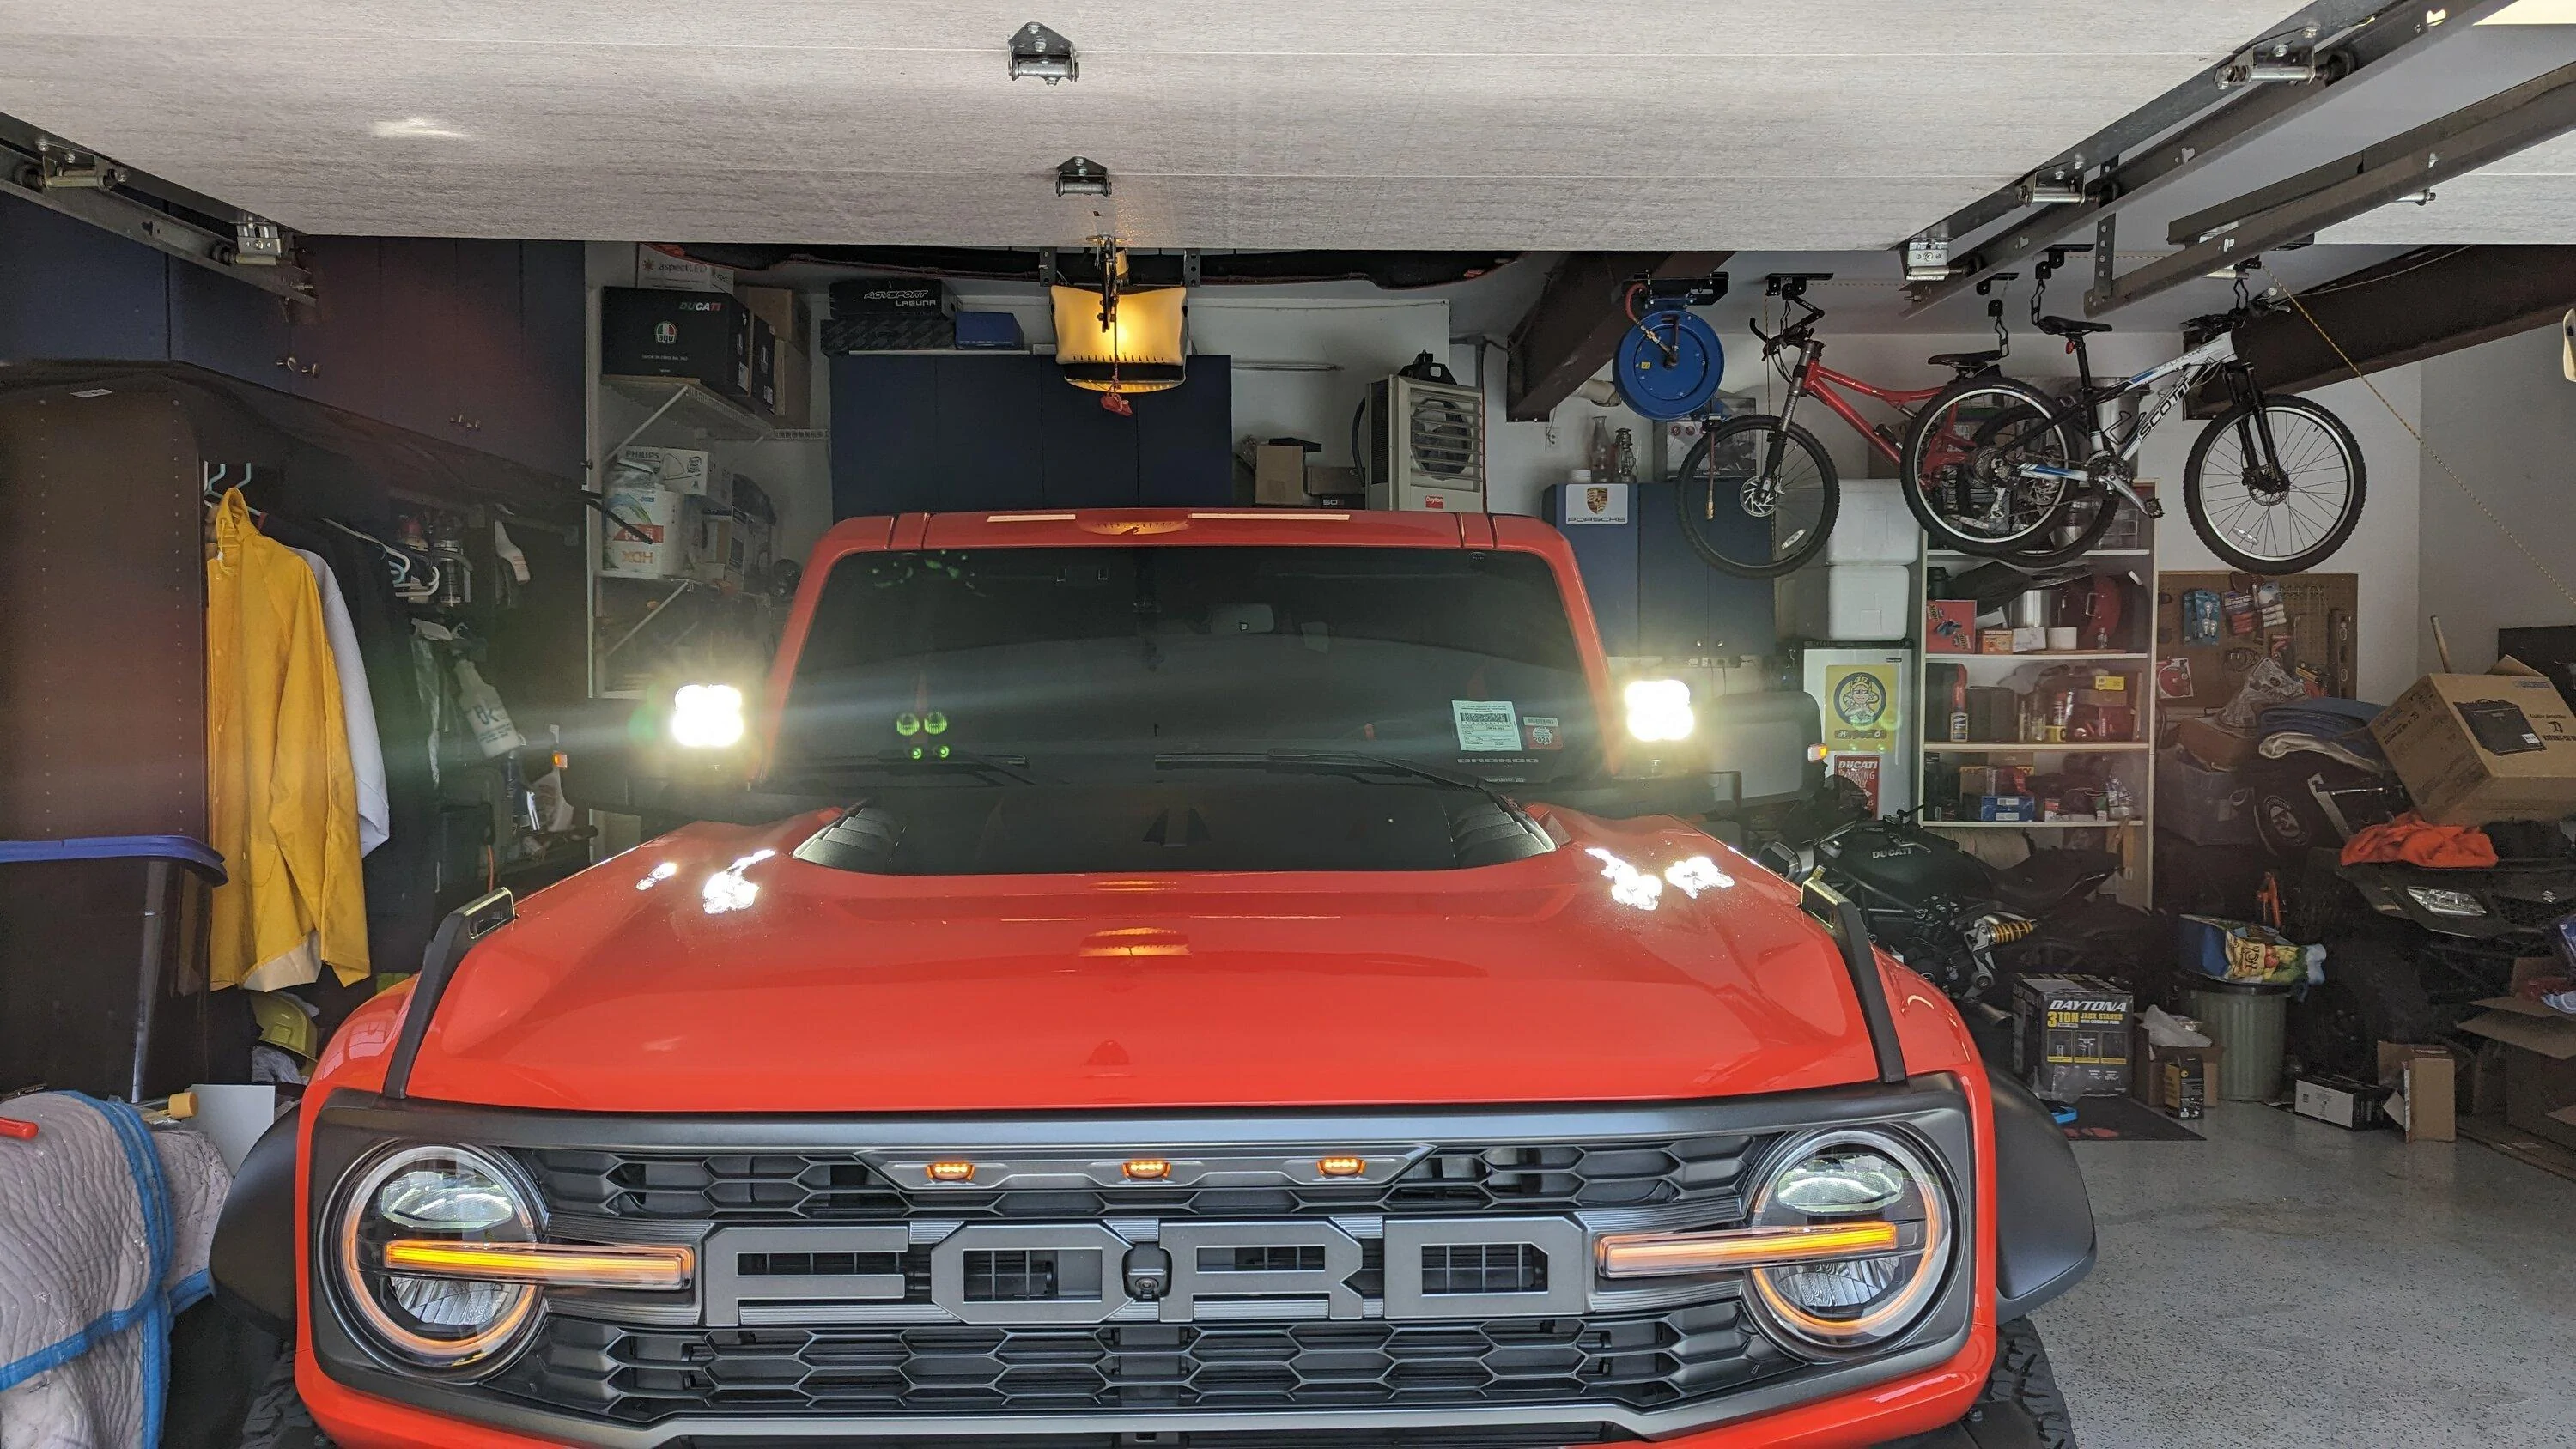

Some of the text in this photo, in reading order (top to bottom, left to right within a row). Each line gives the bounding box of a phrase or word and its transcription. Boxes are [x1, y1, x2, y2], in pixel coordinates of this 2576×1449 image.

[678, 301, 724, 312] DUCATI
[2139, 376, 2190, 439] SCOTT
[625, 450, 659, 459] PHILIPS
[1838, 761, 1879, 769] DUCATI
[1838, 768, 1875, 780] PARKING
[1871, 847, 1911, 859] DUCATI
[2048, 999, 2128, 1012] DAYTONA
[2047, 1011, 2057, 1028] 3
[2057, 1011, 2079, 1023] TON
[704, 1215, 1589, 1328] FORD
